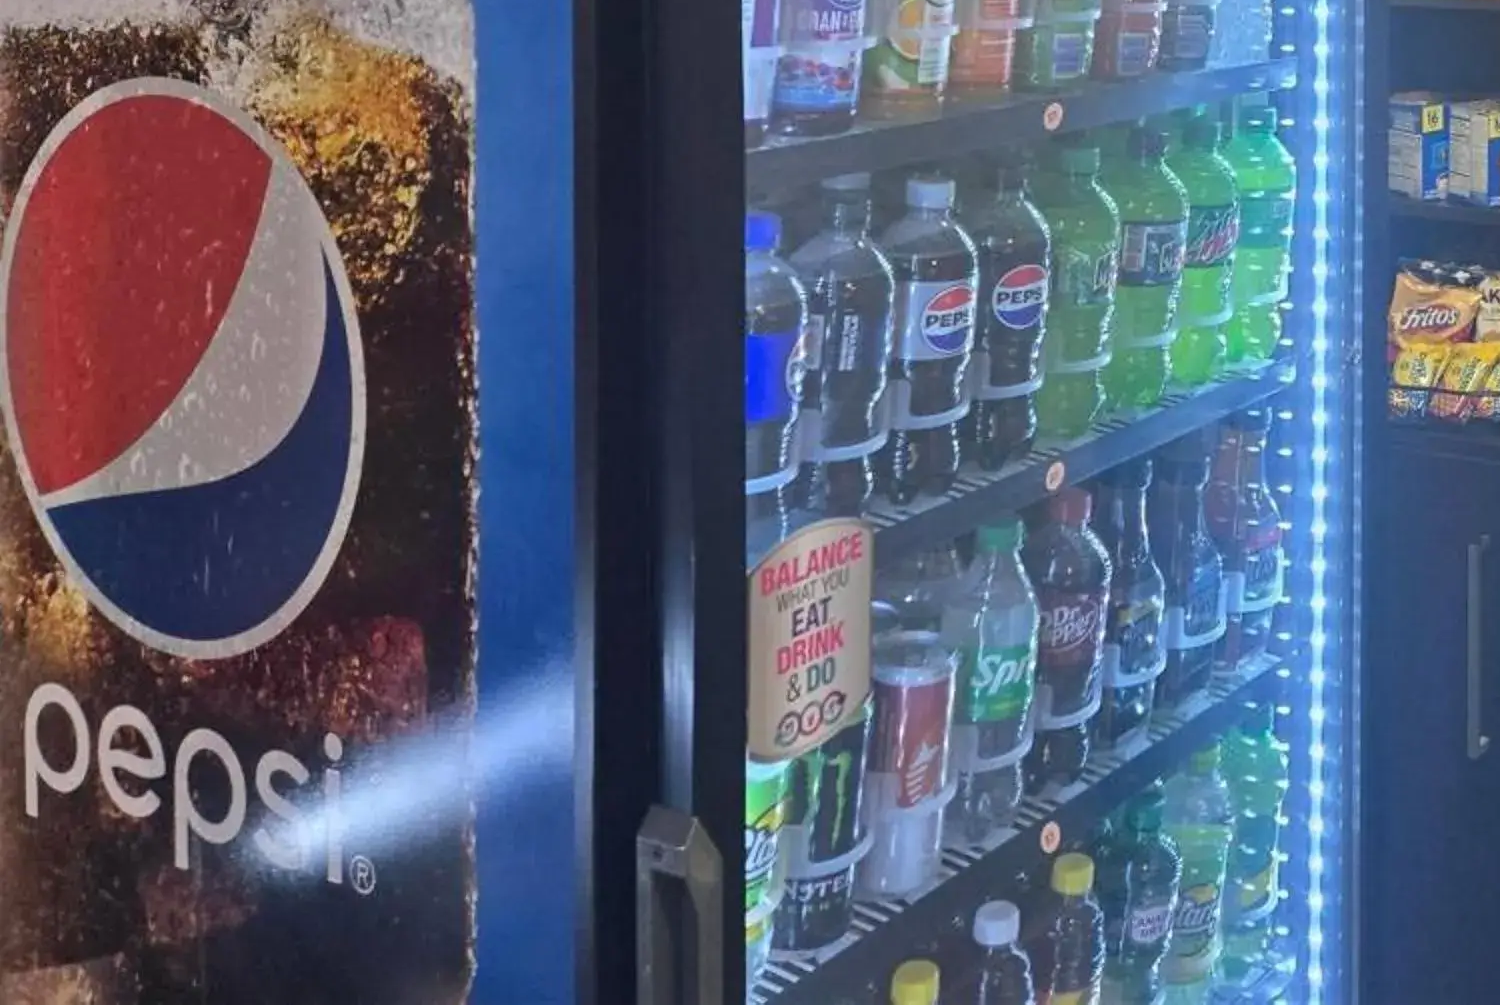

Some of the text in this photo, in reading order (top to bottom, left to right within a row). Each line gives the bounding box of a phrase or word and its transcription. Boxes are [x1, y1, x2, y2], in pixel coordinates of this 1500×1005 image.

[998, 289, 1043, 305] PEPS
[1400, 304, 1457, 330] Fritos
[925, 312, 972, 330] PEPS
[759, 530, 864, 598] BALANCE
[776, 566, 851, 614] WHAT YOU
[790, 597, 832, 639] EAT
[776, 620, 846, 676] DRINK
[785, 655, 838, 703] & DO
[970, 653, 1033, 693] Spri
[22, 681, 344, 885] pepsi
